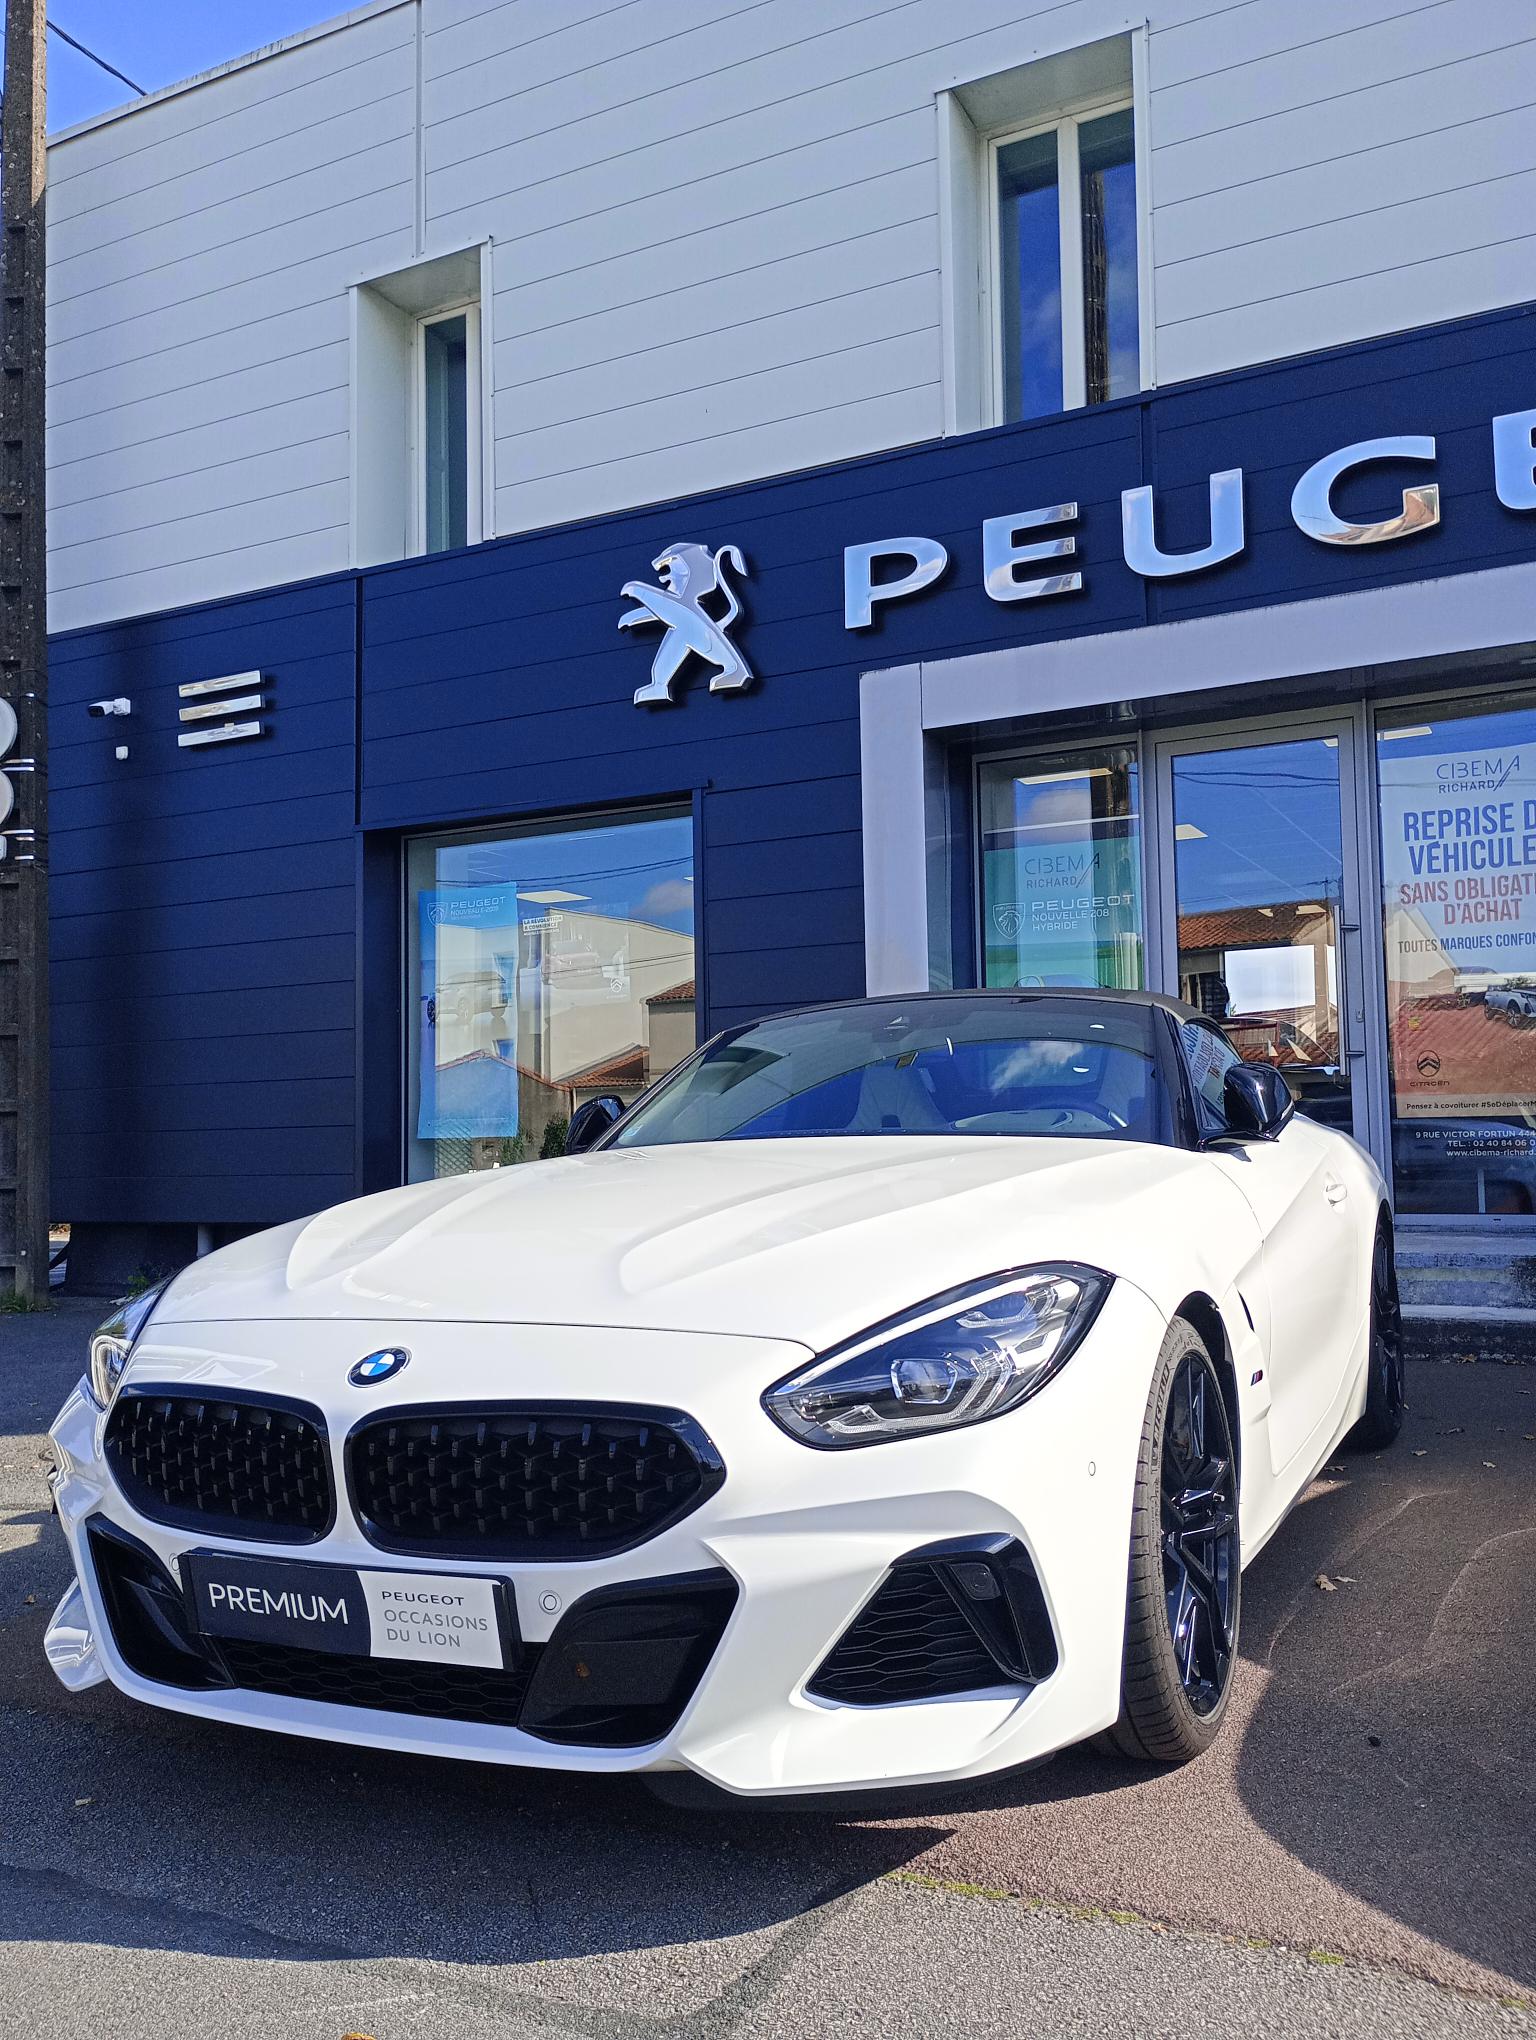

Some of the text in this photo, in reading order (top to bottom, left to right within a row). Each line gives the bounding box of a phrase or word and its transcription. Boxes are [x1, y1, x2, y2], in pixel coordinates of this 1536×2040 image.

[1439, 779, 1495, 793] RICHARD
[1403, 802, 1514, 841] REPRISE
[1408, 834, 1536, 875] VÉHICULE
[1026, 876, 1077, 889] RICHARD
[1400, 880, 1448, 905] SANS
[450, 896, 506, 909] PEUGEOT
[1031, 894, 1135, 912] PEUGEOT
[1032, 909, 1110, 922] NOUVELLE 208
[1443, 899, 1522, 925] D'ACHAT
[1032, 922, 1079, 932] HYBRIDE
[1398, 939, 1437, 953] TOUTES
[1440, 935, 1493, 951] MARQUES
[1406, 1103, 1432, 1111] Pensez
[1440, 1102, 1479, 1110] covoiturer
[1423, 1131, 1440, 1139] RUE
[1443, 1130, 1476, 1138] VICTOR
[1478, 1130, 1516, 1138] FORTUN
[208, 1583, 349, 1625] PREMIUM
[382, 1591, 464, 1606] PEUGEOT
[384, 1609, 488, 1631] OCCASIONS
[387, 1628, 461, 1648] DU LION
